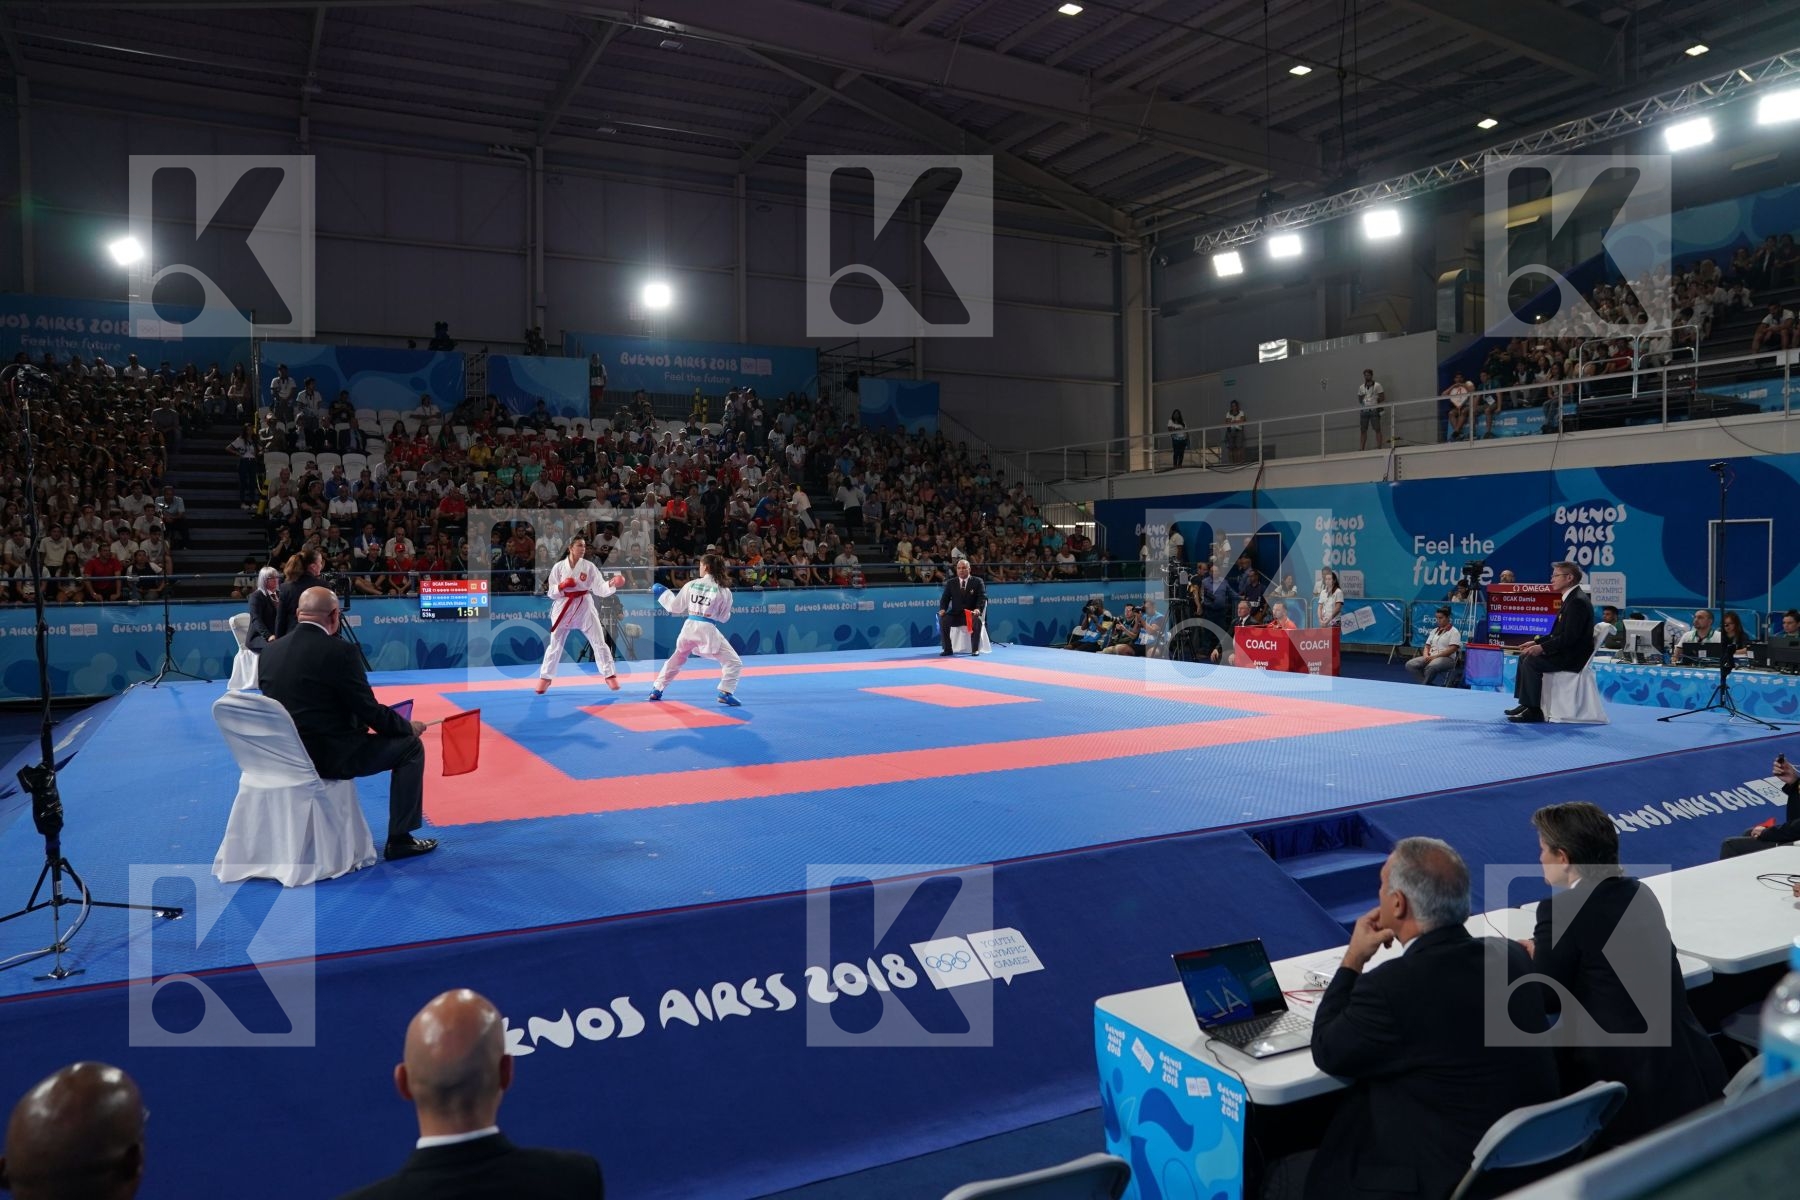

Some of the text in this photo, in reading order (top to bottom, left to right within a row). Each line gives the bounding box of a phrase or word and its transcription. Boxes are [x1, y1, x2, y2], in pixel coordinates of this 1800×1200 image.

[35, 315, 85, 332] AIRES
[89, 320, 130, 336] 2018
[620, 351, 738, 371] BUENOS AIRES 2018
[1554, 504, 1627, 524] BUENOS
[1314, 515, 1365, 531] BUENOS
[1322, 532, 1357, 547] AIRES
[1564, 525, 1616, 544] AIRES
[1414, 532, 1495, 555] Feel the
[1322, 548, 1356, 566] 2018
[1564, 545, 1616, 566] 2018
[1413, 555, 1494, 587] futue
[481, 581, 487, 590] 0
[481, 596, 488, 604] 0
[794, 602, 857, 612] BUENOS AIRES 2018
[457, 607, 479, 617] 1:51
[112, 624, 152, 633] BUENOS
[184, 622, 207, 631] 2018
[374, 615, 409, 625] BUENOS
[1245, 639, 1277, 651] COACH
[1300, 639, 1330, 651] COACH
[1661, 795, 1724, 820] AIRES
[1709, 787, 1766, 811] 2018
[980, 935, 1016, 949] YOUTH
[983, 945, 1027, 960] OLYMPIC
[993, 956, 1030, 969] GAMES
[659, 972, 797, 1030] AIRES
[804, 953, 918, 1004] 2018
